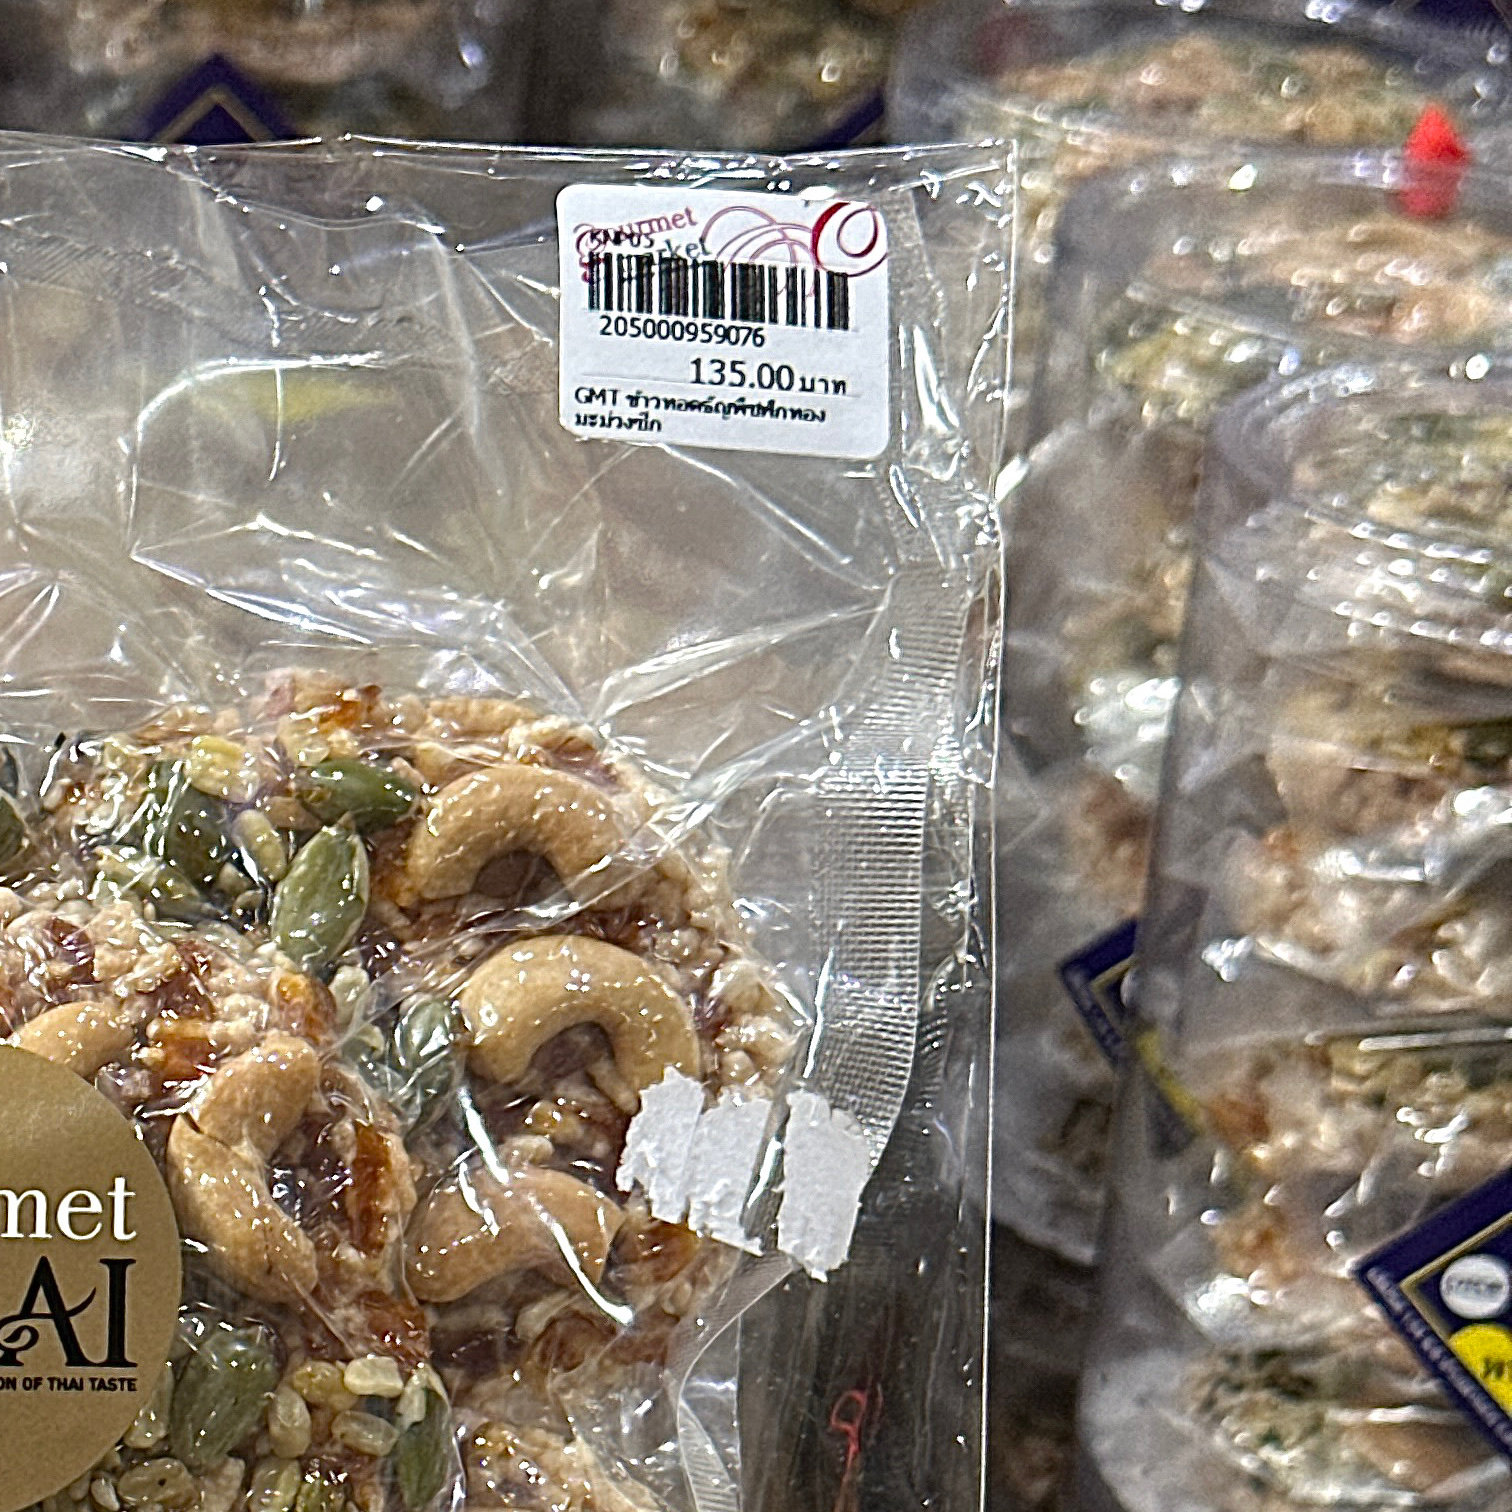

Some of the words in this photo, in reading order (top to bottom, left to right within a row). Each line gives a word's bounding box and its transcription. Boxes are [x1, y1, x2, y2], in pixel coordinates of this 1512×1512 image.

[599, 314, 766, 347] 205000959076
[574, 387, 619, 407] GMT
[22, 1376, 42, 1391] OF
[48, 1376, 84, 1391] THAI
[88, 1376, 137, 1392] TASTE
